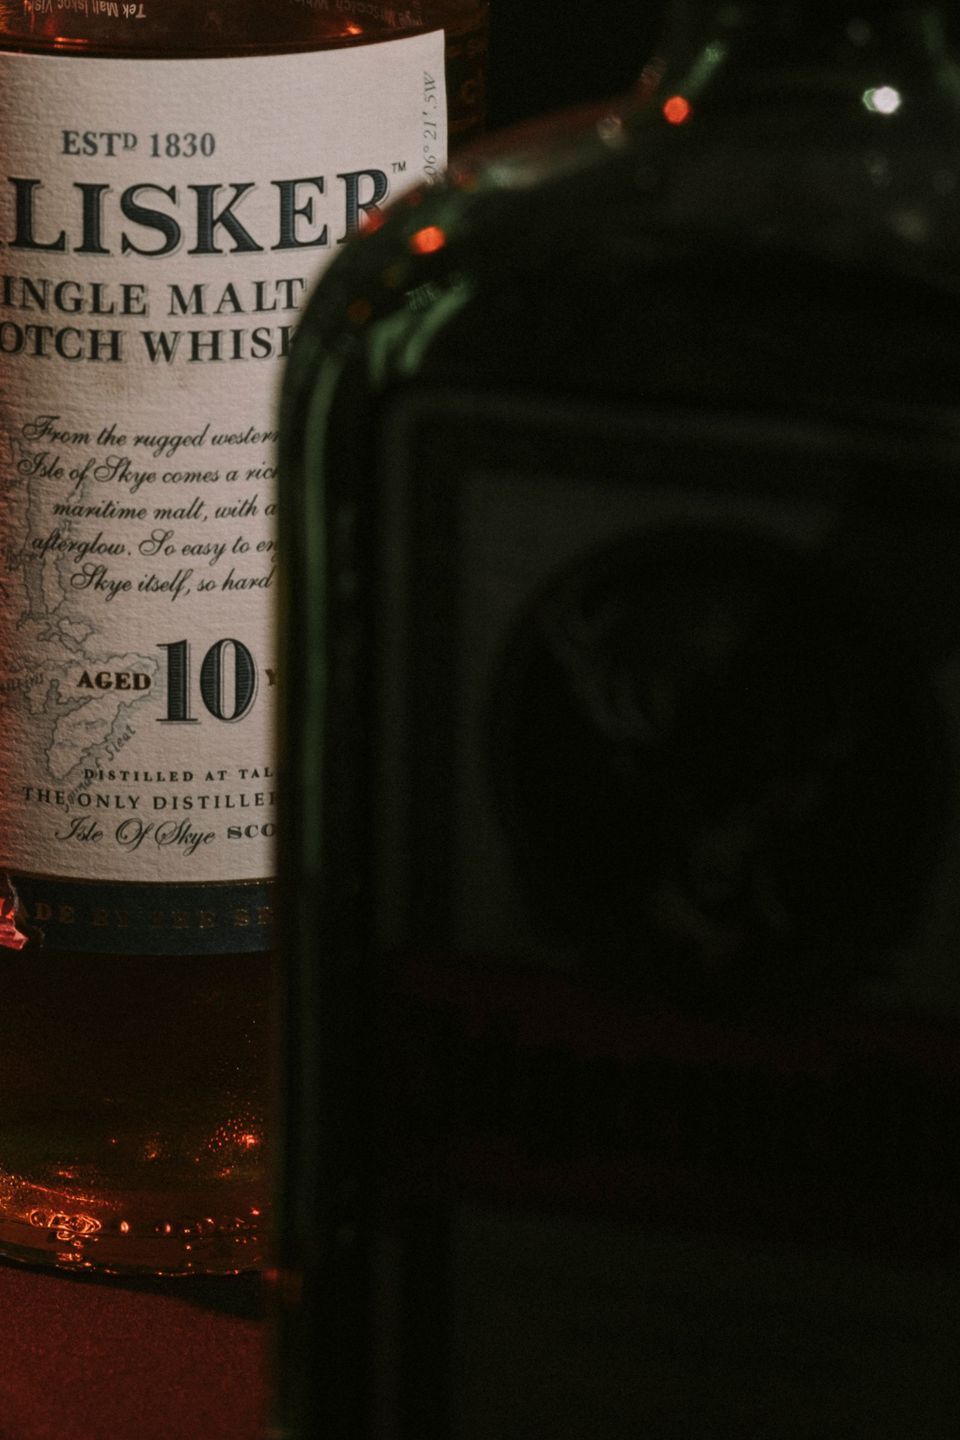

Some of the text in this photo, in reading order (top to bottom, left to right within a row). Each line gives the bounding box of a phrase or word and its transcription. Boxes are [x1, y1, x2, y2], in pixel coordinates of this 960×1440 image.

[149, 131, 216, 158] 1830
[167, 277, 307, 317] MALT
[22, 415, 90, 446] From
[97, 423, 127, 446] the
[133, 423, 210, 458] rugged
[17, 452, 64, 478] Isle
[69, 458, 96, 489] of
[94, 455, 156, 493] Skye
[162, 469, 219, 484] comes
[226, 470, 239, 482] a
[53, 500, 146, 520] maritime
[154, 497, 207, 522] malt,
[215, 494, 258, 518] with
[32, 528, 131, 564] afterglow.
[138, 528, 175, 556] So
[182, 541, 226, 566] easy
[232, 535, 250, 554] to
[70, 562, 274, 602] Skye itself, so hard
[76, 670, 153, 691] AGED
[155, 638, 259, 725] 10
[84, 768, 194, 782] DISTILLED
[205, 769, 228, 782] AT
[22, 786, 66, 806] THE
[77, 793, 141, 810] ONLY
[54, 815, 104, 844] Isle
[115, 817, 154, 854] Of
[154, 817, 216, 857] Skye
